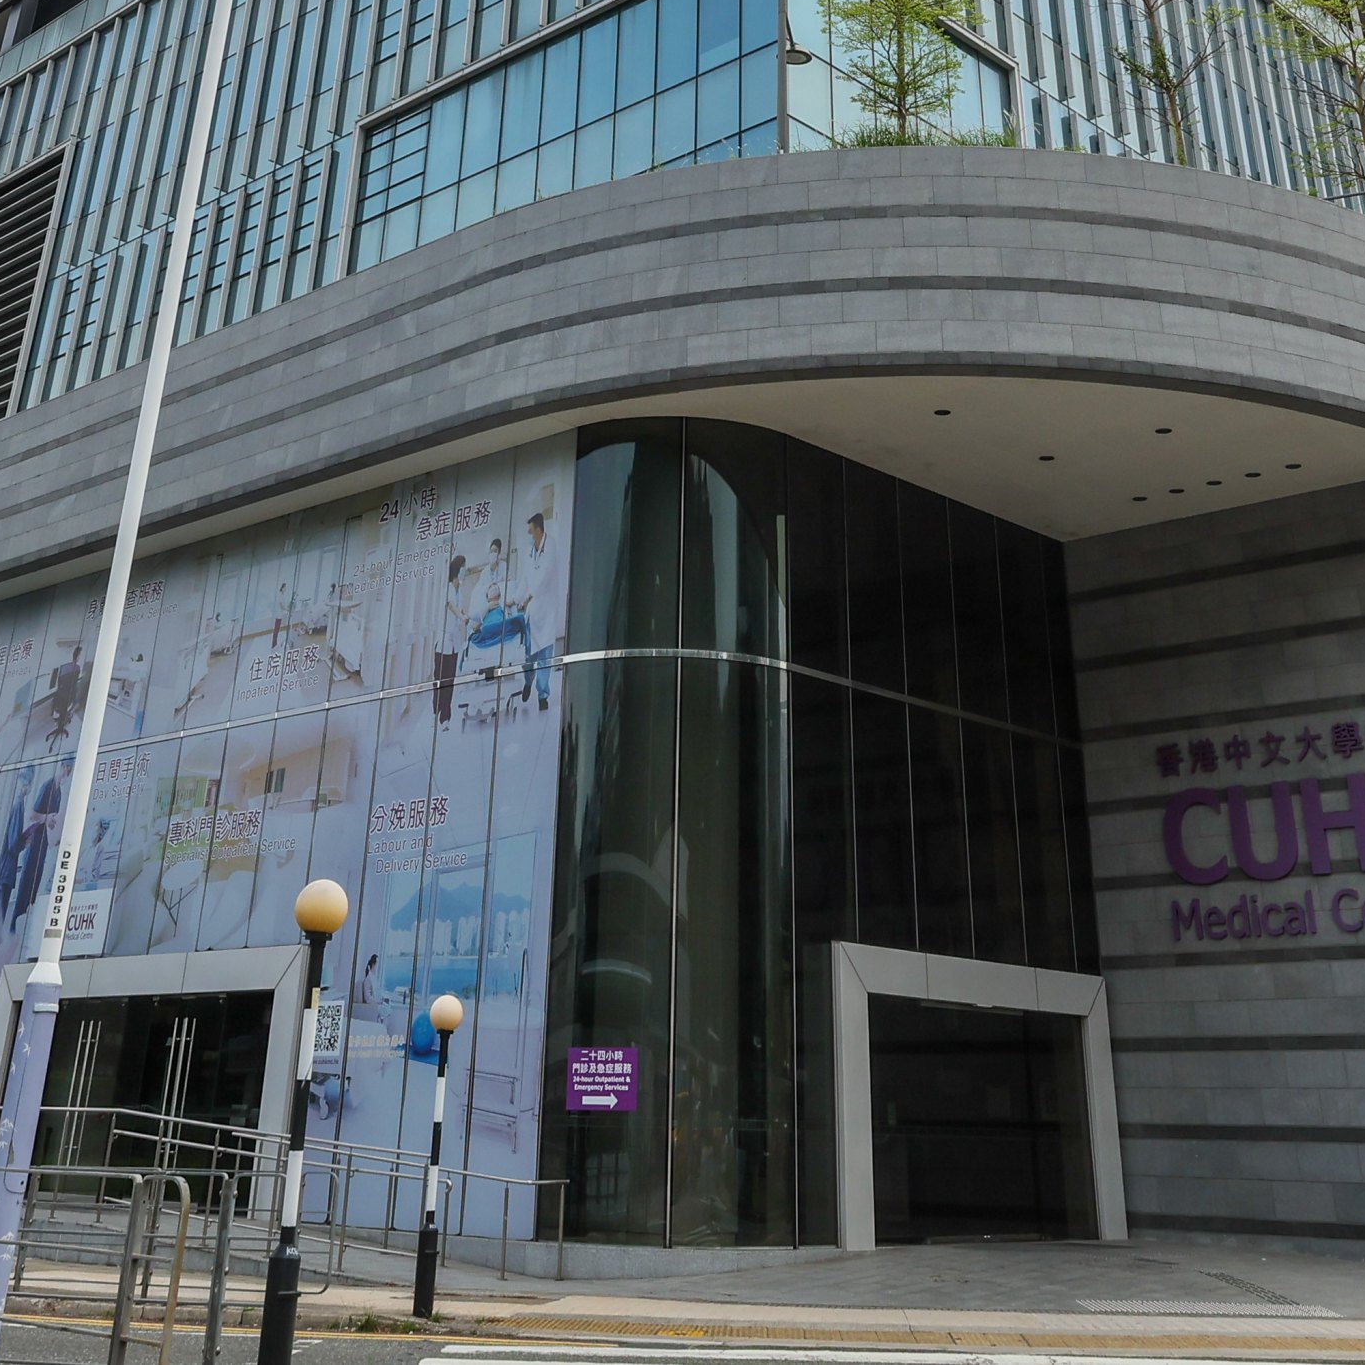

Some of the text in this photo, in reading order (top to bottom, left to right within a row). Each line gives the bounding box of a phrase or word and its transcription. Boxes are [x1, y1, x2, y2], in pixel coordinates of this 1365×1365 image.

[415, 500, 491, 541] 急症服務
[396, 541, 457, 566] Emergency
[344, 565, 435, 596] Medicine Service
[249, 645, 319, 682] 住院服務
[237, 675, 319, 702] Inpatient Service
[96, 753, 150, 783] 日間手術
[168, 809, 261, 846] 專科門診服務
[370, 795, 449, 834] 分娩服務
[260, 838, 296, 853] Service
[367, 834, 434, 855] Labour and
[376, 852, 467, 874] Delivery Service
[67, 913, 96, 931] CUHK
[1171, 889, 1318, 942] Medical
[572, 1063, 632, 1074] 門診及急症服務
[580, 1050, 623, 1061] 二十四小時
